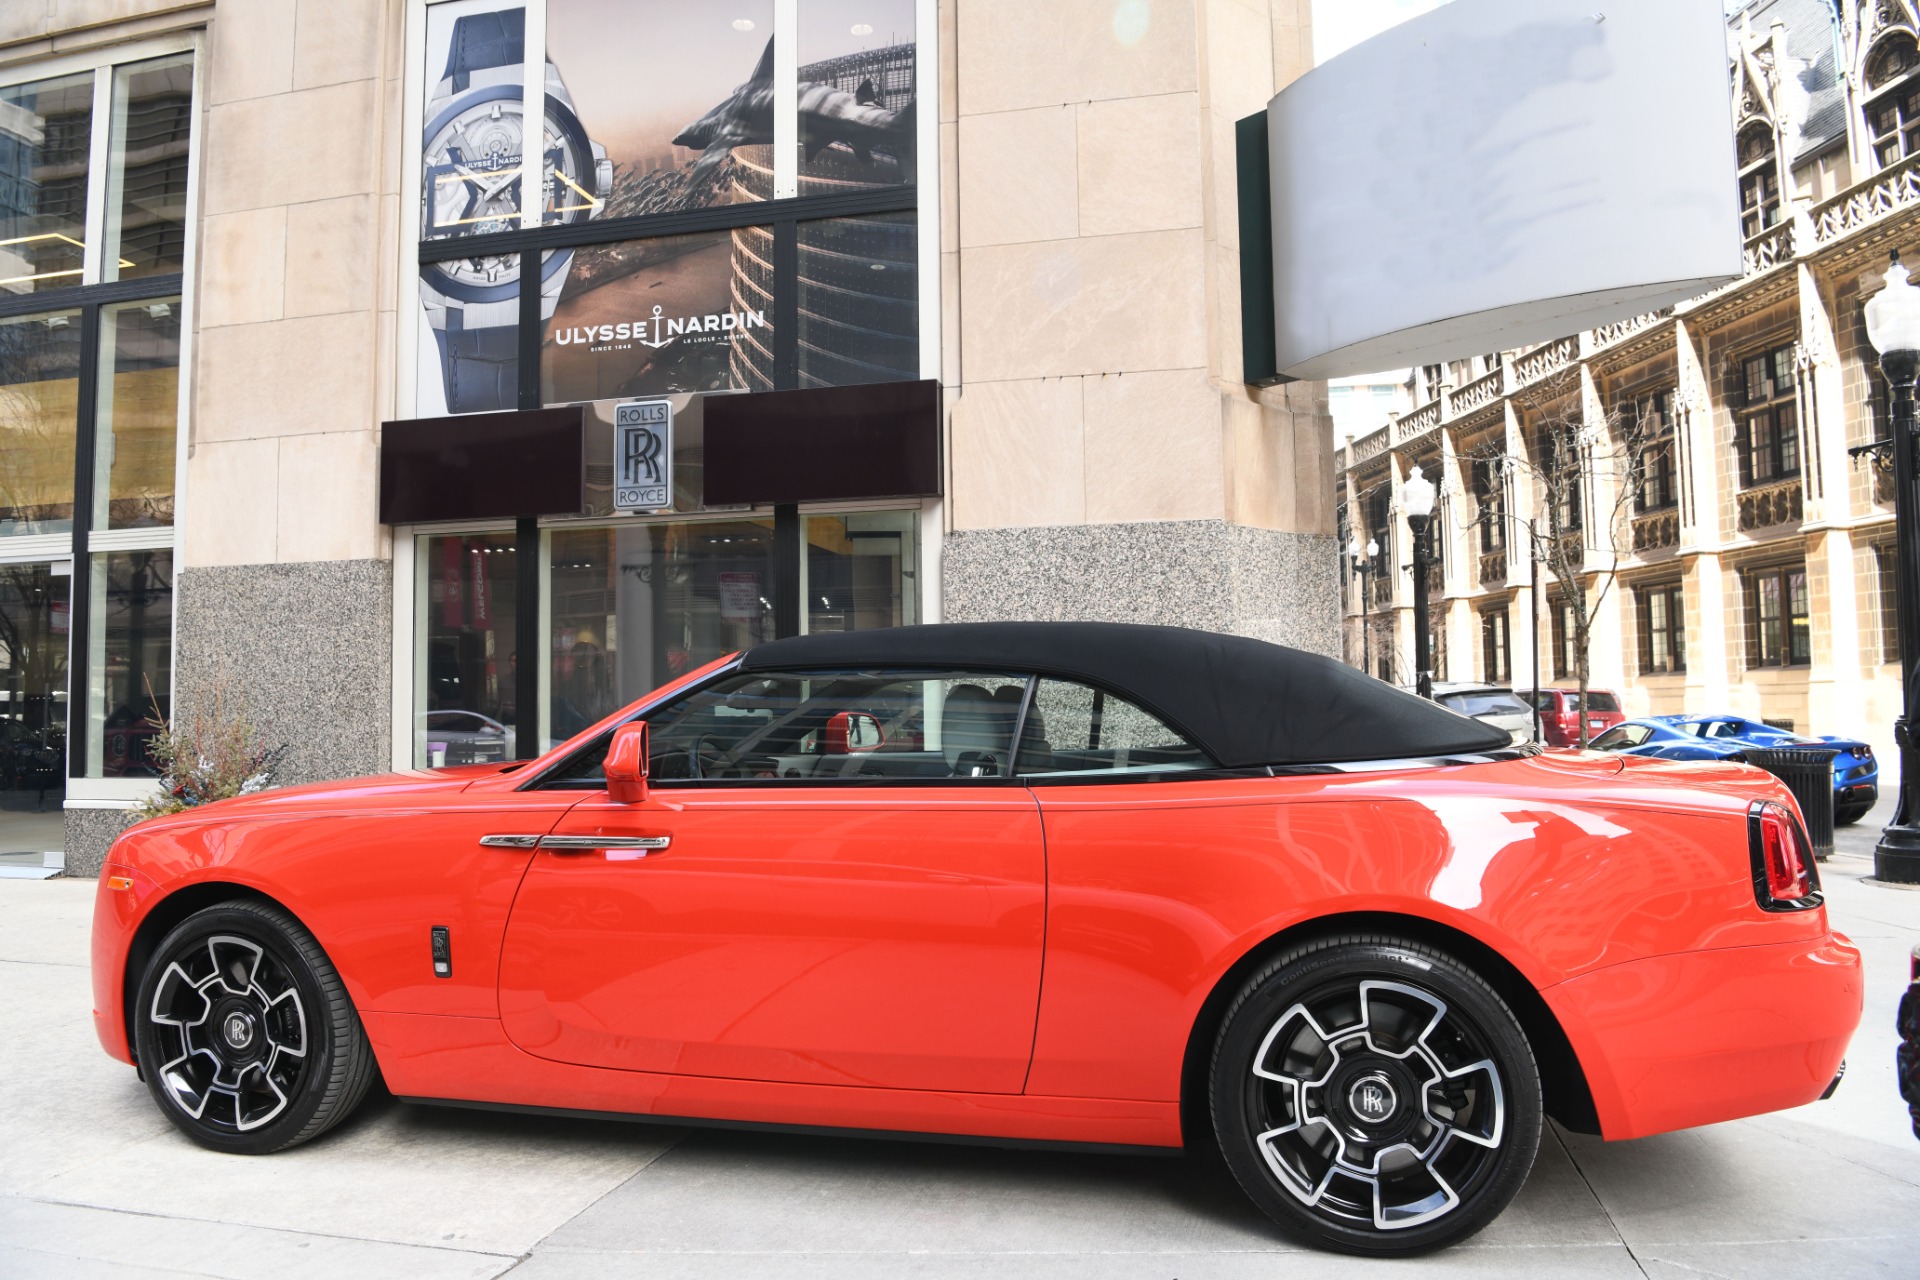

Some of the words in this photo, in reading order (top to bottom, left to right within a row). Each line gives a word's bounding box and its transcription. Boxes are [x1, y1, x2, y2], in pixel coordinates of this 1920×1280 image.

[464, 160, 492, 168] ULYSSE
[498, 156, 522, 164] NARDI
[555, 322, 647, 346] ULYSSE
[667, 310, 764, 336] NARDIN
[620, 408, 664, 422] ROLLS
[624, 428, 662, 484] RR
[620, 488, 664, 502] ROYCE
[232, 1019, 246, 1040] RR
[1362, 1086, 1383, 1112] RR
